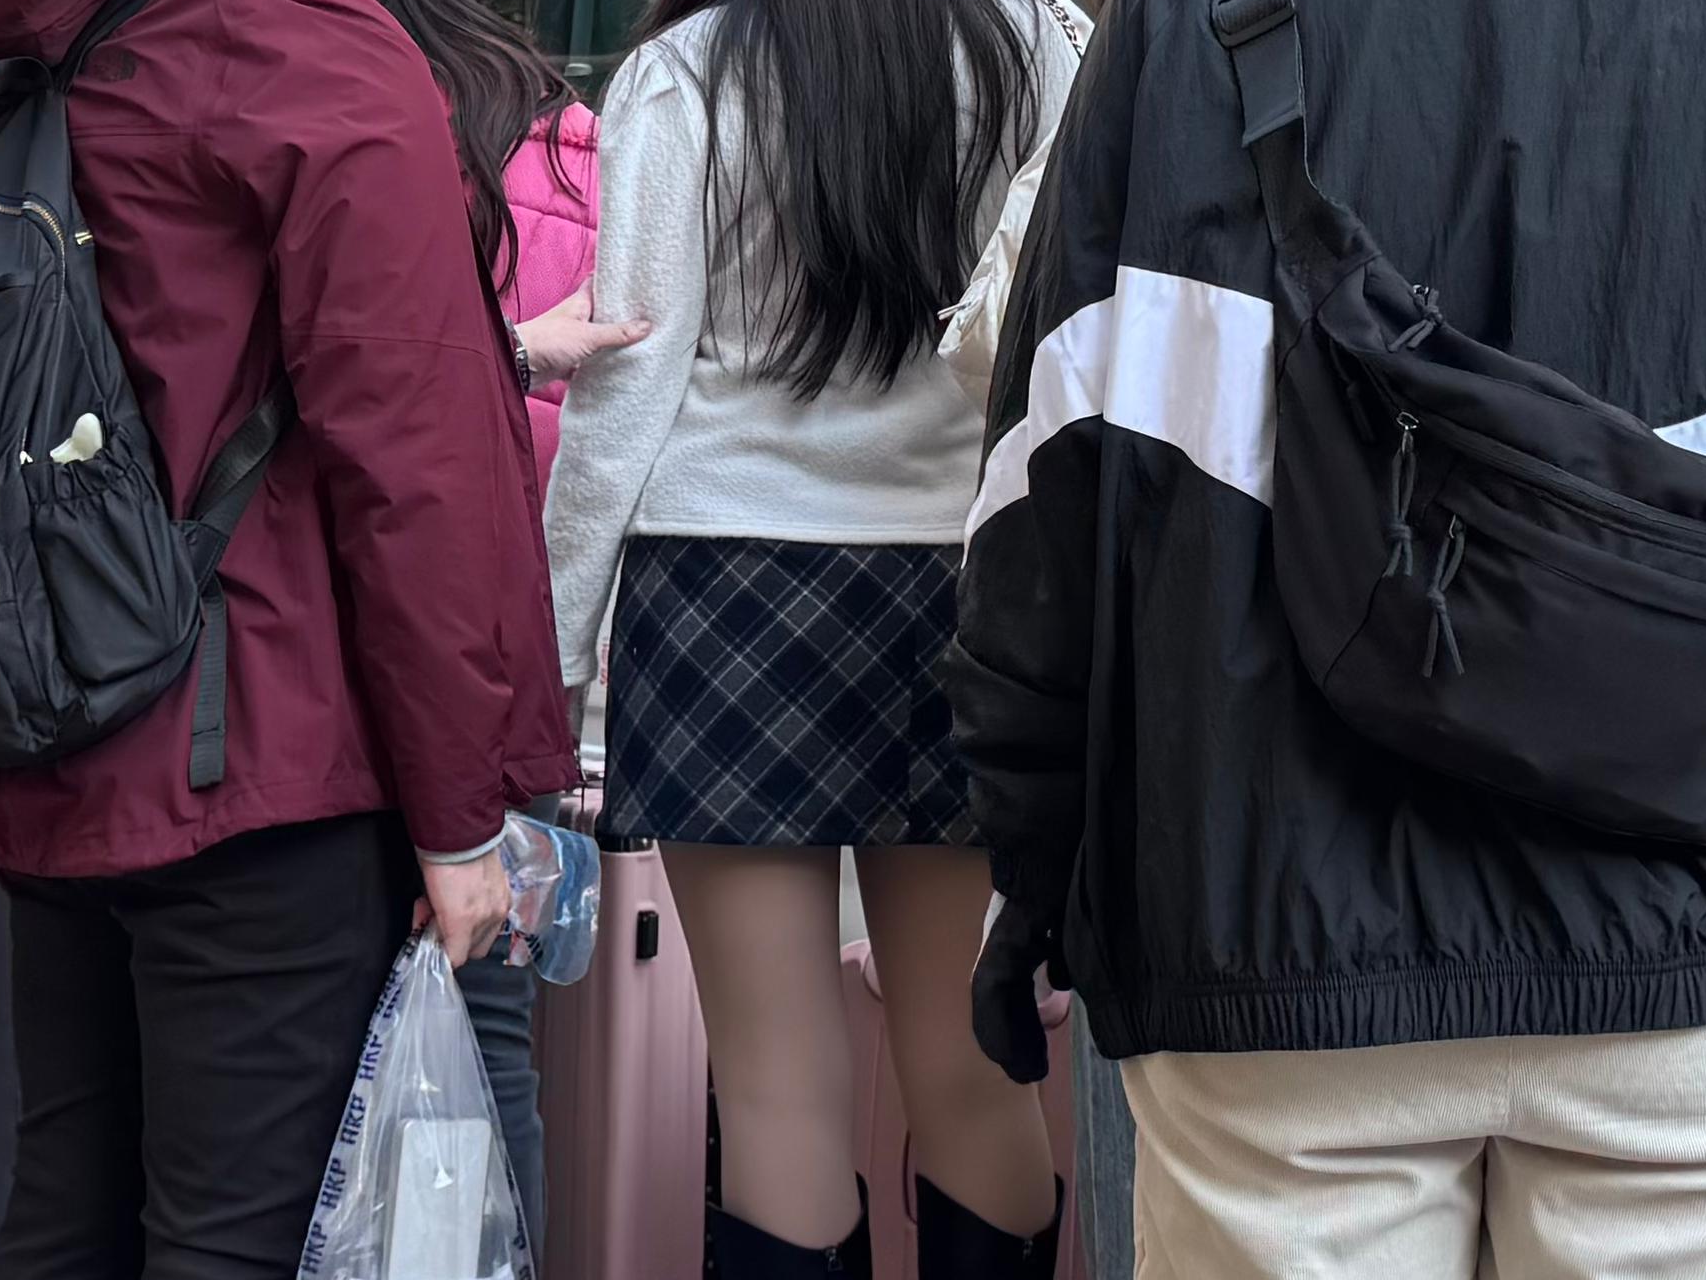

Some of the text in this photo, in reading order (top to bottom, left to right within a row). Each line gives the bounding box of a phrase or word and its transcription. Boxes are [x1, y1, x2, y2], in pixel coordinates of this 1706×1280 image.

[339, 1092, 367, 1146] HKP
[320, 1157, 347, 1211] HKP
[301, 1220, 328, 1274] HKP
